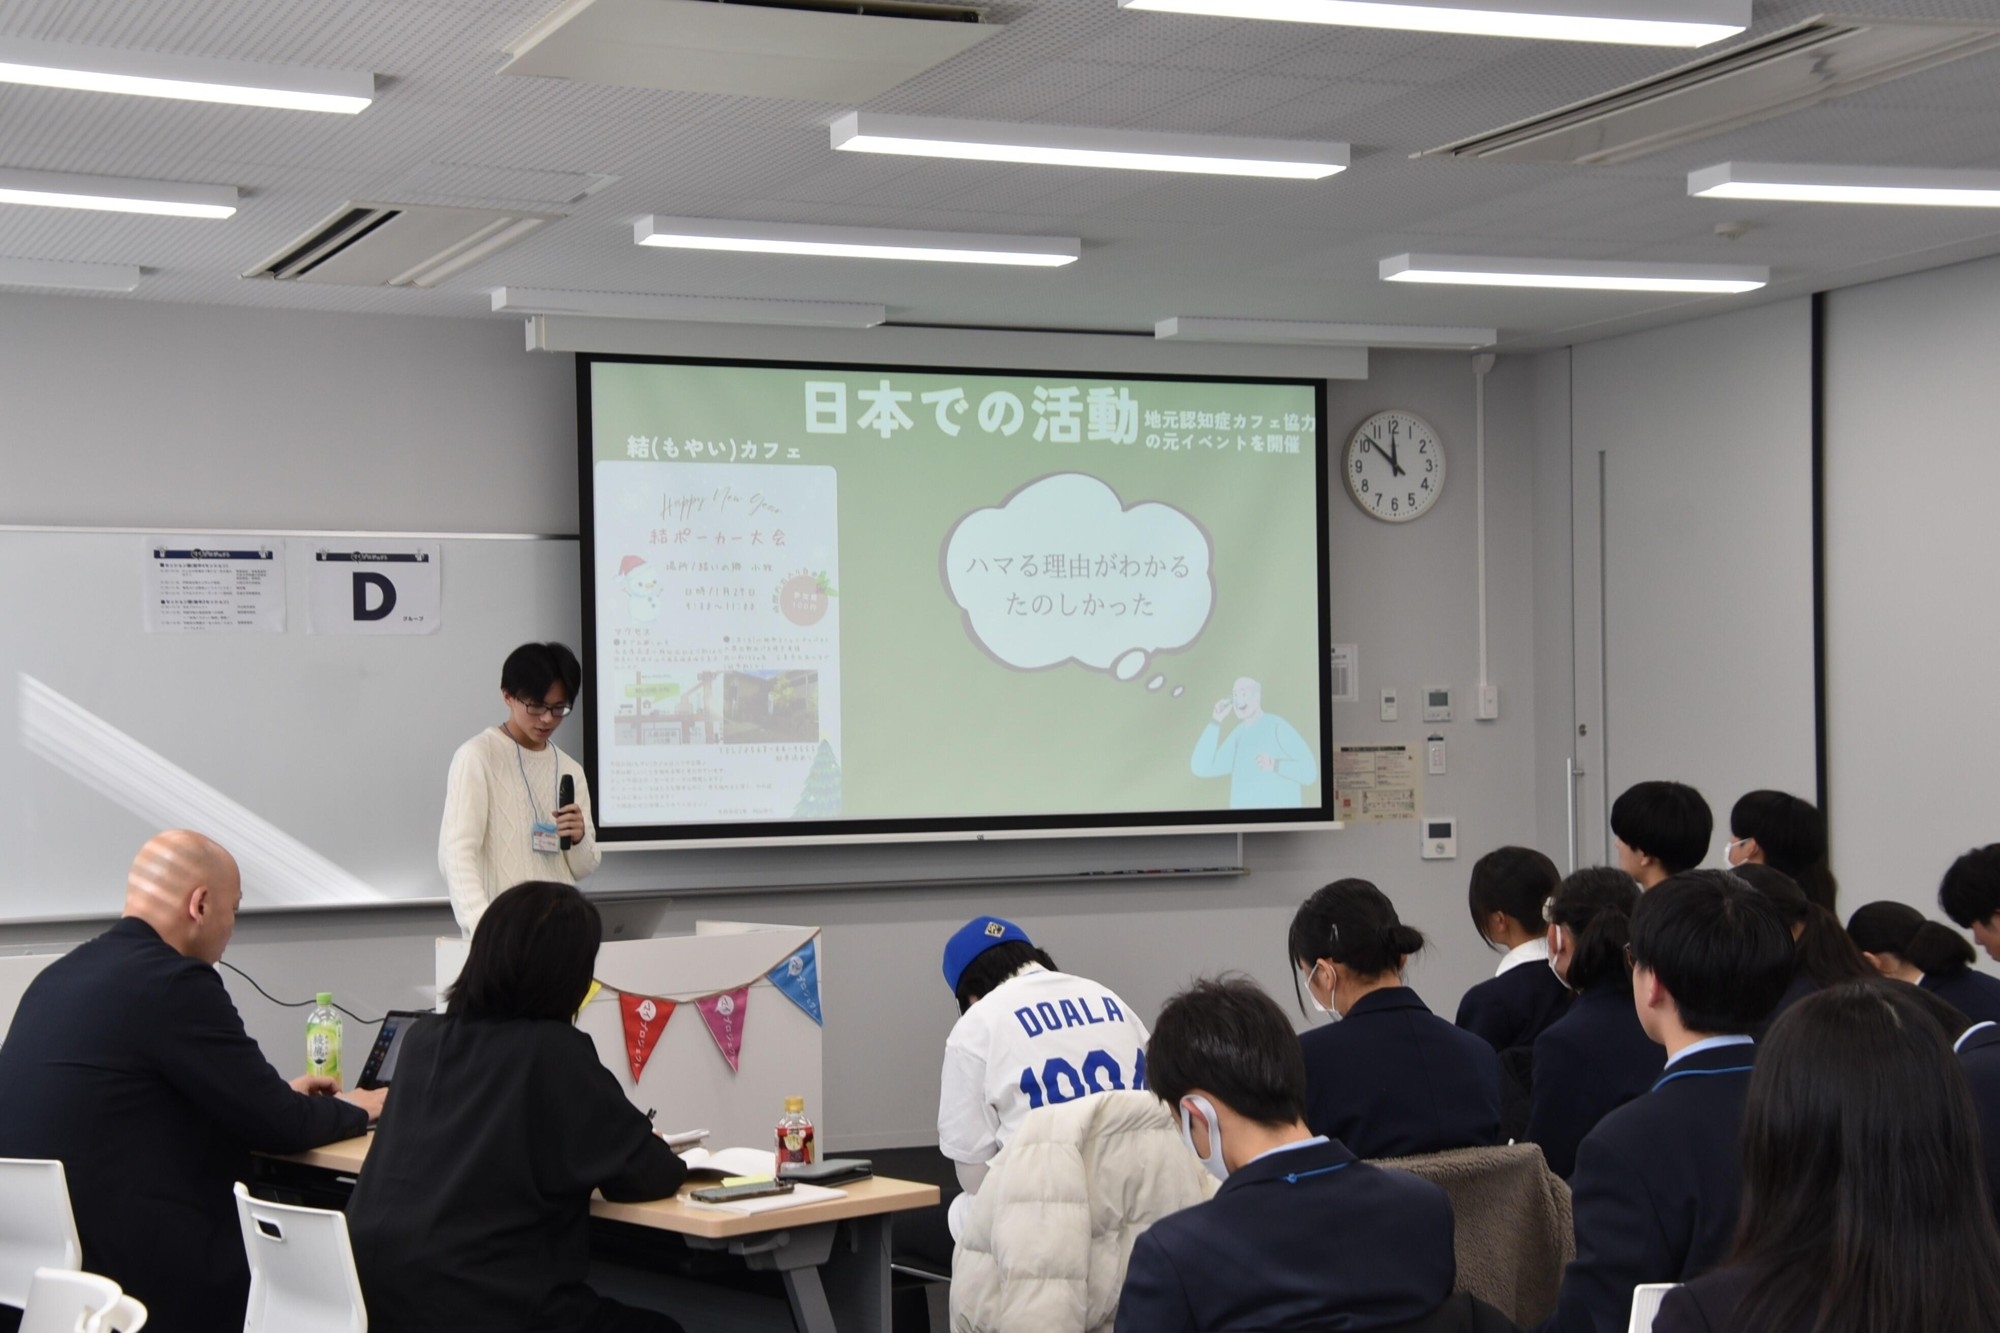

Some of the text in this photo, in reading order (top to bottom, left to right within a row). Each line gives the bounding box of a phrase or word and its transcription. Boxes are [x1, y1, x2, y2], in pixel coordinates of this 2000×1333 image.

[805, 380, 1138, 444] 日本での活動
[1144, 410, 1316, 432] 地元認知症カフェ協力
[1388, 420, 1399, 435] 12
[1373, 425, 1381, 439] 11
[1409, 425, 1412, 439] 1
[627, 435, 801, 462] 結(もやい)カフェ
[1146, 433, 1300, 453] の元イベントを開催
[1360, 439, 1370, 453] 10
[1419, 439, 1427, 454] 2
[1355, 459, 1362, 473] 9
[1426, 459, 1433, 472] 3
[1361, 479, 1369, 492] 8
[1421, 477, 1429, 490] 4
[1375, 493, 1382, 507] 7
[1391, 498, 1398, 511] 6
[1408, 493, 1415, 506] 5
[649, 528, 787, 547] 結ポーカー大会
[966, 553, 1190, 579] ハマる理由がわかる
[353, 571, 397, 621] D
[1006, 592, 1154, 616] たのしかった
[1015, 996, 1124, 1038] DOALA
